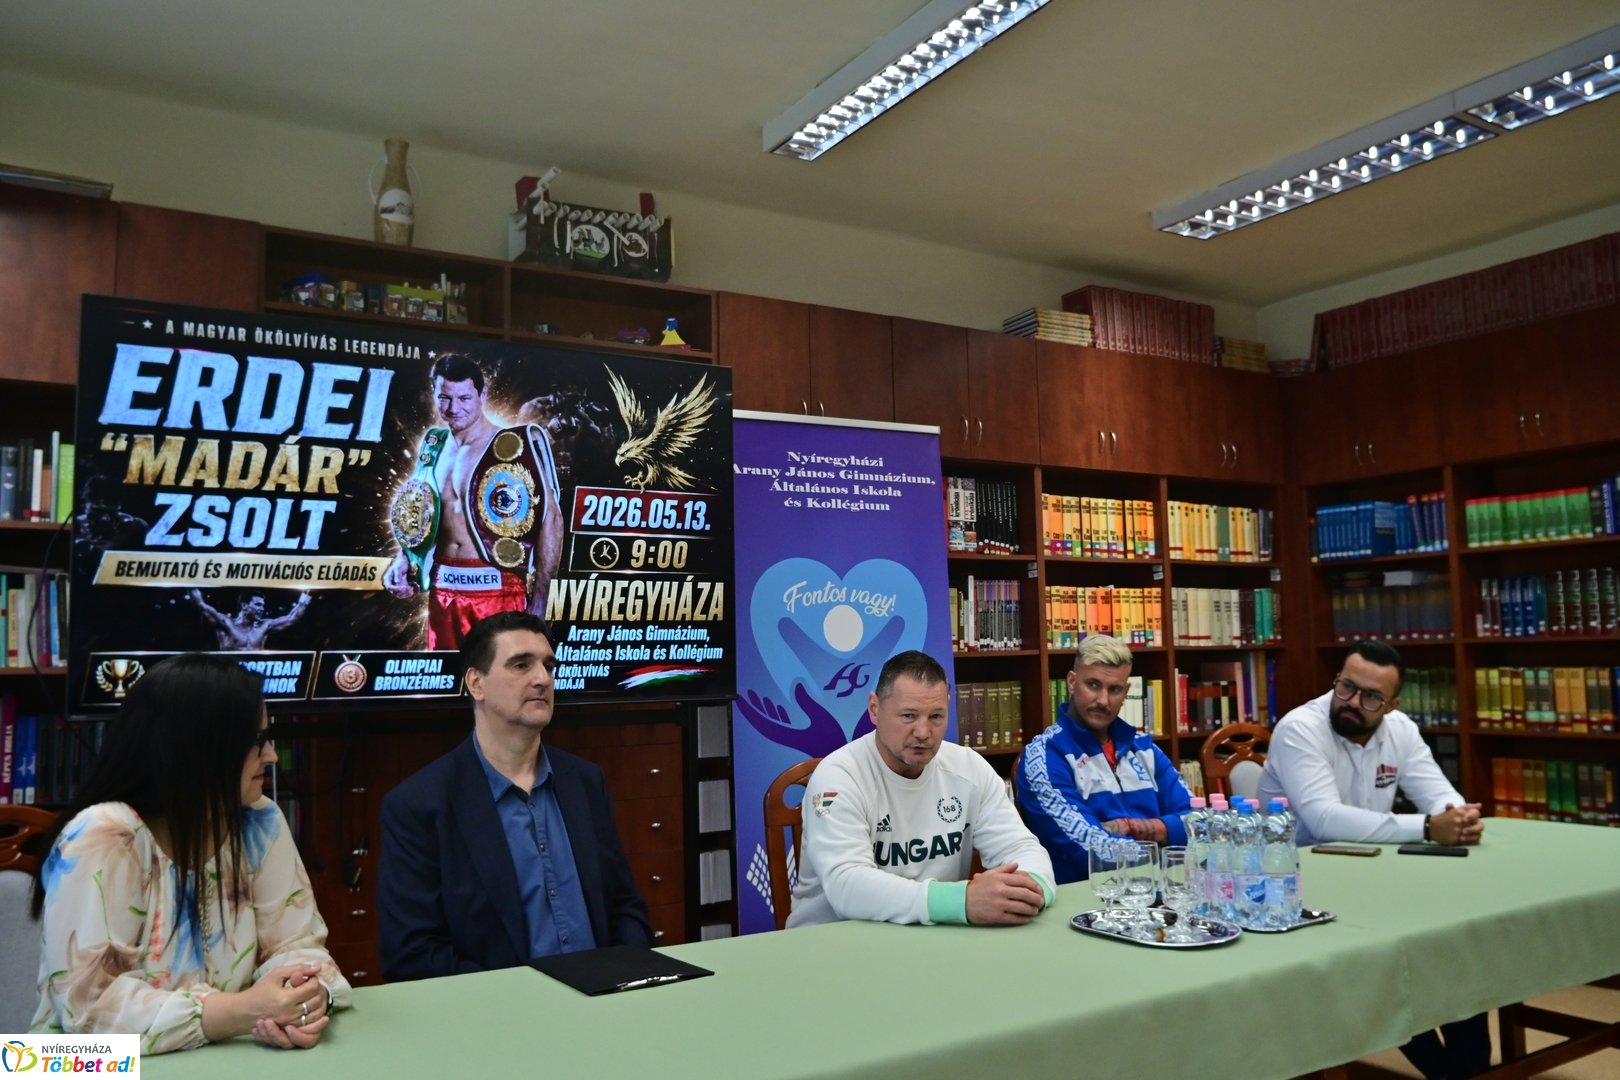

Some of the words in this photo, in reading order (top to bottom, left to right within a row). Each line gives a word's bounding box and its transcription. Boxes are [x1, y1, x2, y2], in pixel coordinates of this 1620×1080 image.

[166, 319, 175, 335] A
[183, 322, 247, 342] MAGYAR
[254, 327, 338, 351] ÖKÖLVÍVÁS
[344, 338, 422, 360] LEGENDÁJA
[98, 343, 395, 443] ERDEI
[786, 451, 884, 467] Nyíregyházi
[733, 463, 782, 479] Arany
[785, 466, 835, 479] János
[839, 469, 936, 485] Gimnázium,
[769, 479, 849, 495] Általános
[853, 485, 902, 497] Iskola
[581, 495, 711, 531] 2026.05.13.
[784, 497, 802, 508] és
[806, 498, 890, 512] Kollégium
[145, 493, 337, 550] ZSOLT
[631, 539, 688, 569] 9:00
[115, 559, 199, 579] BEMUTATÓ
[203, 560, 222, 579] ÉS
[226, 560, 313, 580] MOTIVÁCIÓS
[443, 572, 499, 586] SCHENKER
[545, 573, 724, 621] NYÍREGYHÁZA
[783, 580, 846, 613] Fontos
[850, 588, 897, 617] vagy!
[567, 625, 605, 644] Arany
[607, 625, 643, 641] János
[645, 624, 711, 642] Gimnázium,
[555, 642, 612, 661] Általános
[615, 645, 650, 661] Iskola
[653, 645, 666, 660] és
[669, 644, 723, 662] Kollégium
[384, 658, 443, 674] OLIMPIAI
[558, 664, 610, 678] ÖKÖLVÍVÁS
[374, 672, 455, 691] BRONZÉRMES
[553, 677, 585, 690] NDÁJA
[943, 804, 956, 813] 168
[873, 823, 970, 867] UNGAR
